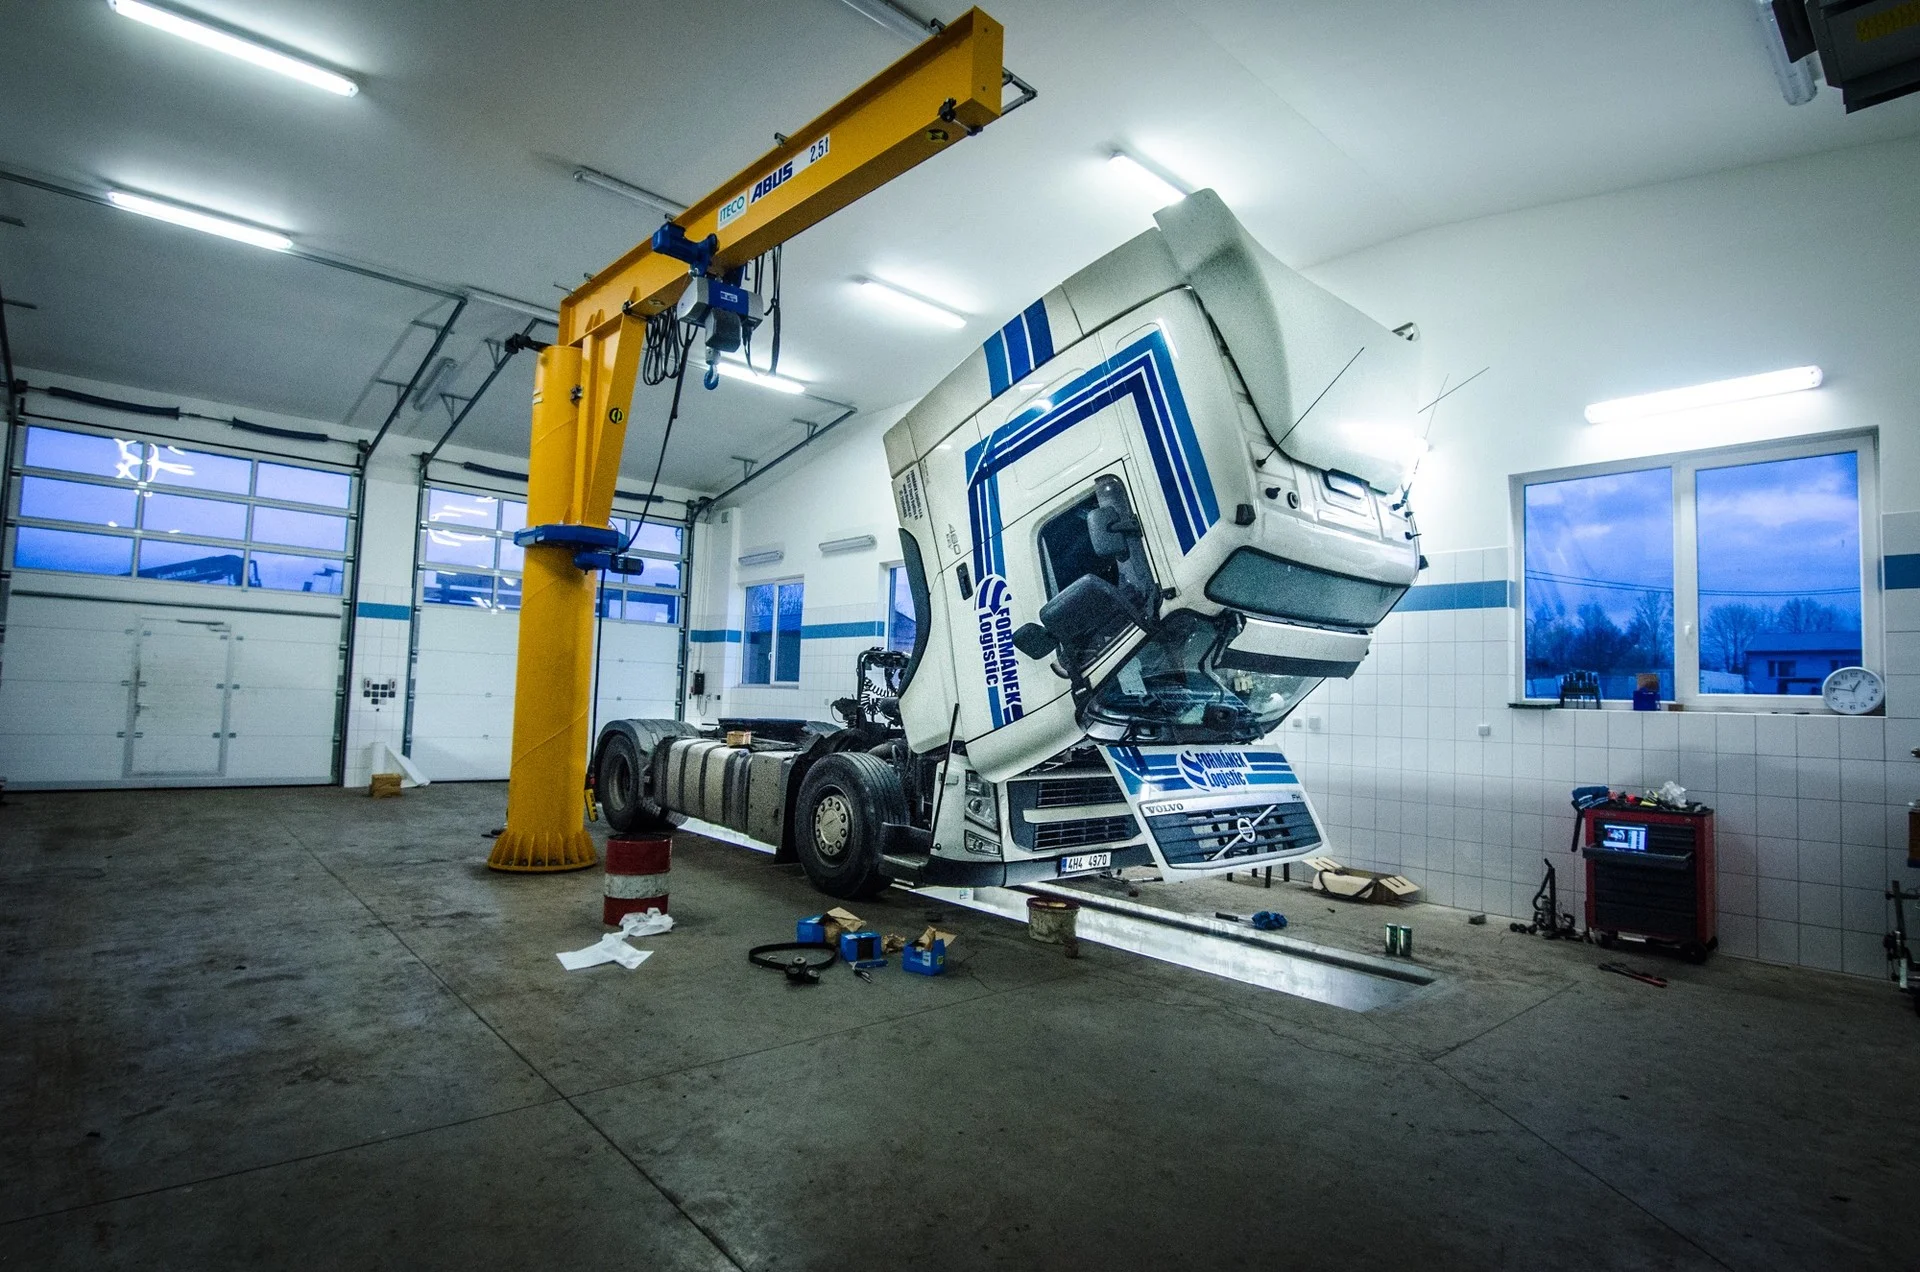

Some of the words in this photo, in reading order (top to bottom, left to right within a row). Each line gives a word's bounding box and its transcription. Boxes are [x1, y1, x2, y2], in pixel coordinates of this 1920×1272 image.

[751, 161, 793, 204] ABUS
[719, 195, 746, 222] ITECO
[978, 612, 999, 687] Logistic
[995, 607, 1022, 706] FORMÁNEK
[1194, 749, 1248, 769] FORMÁNEK
[1204, 769, 1247, 789] Logistic
[1145, 803, 1184, 814] VOLVO
[1088, 854, 1108, 868] 4970
